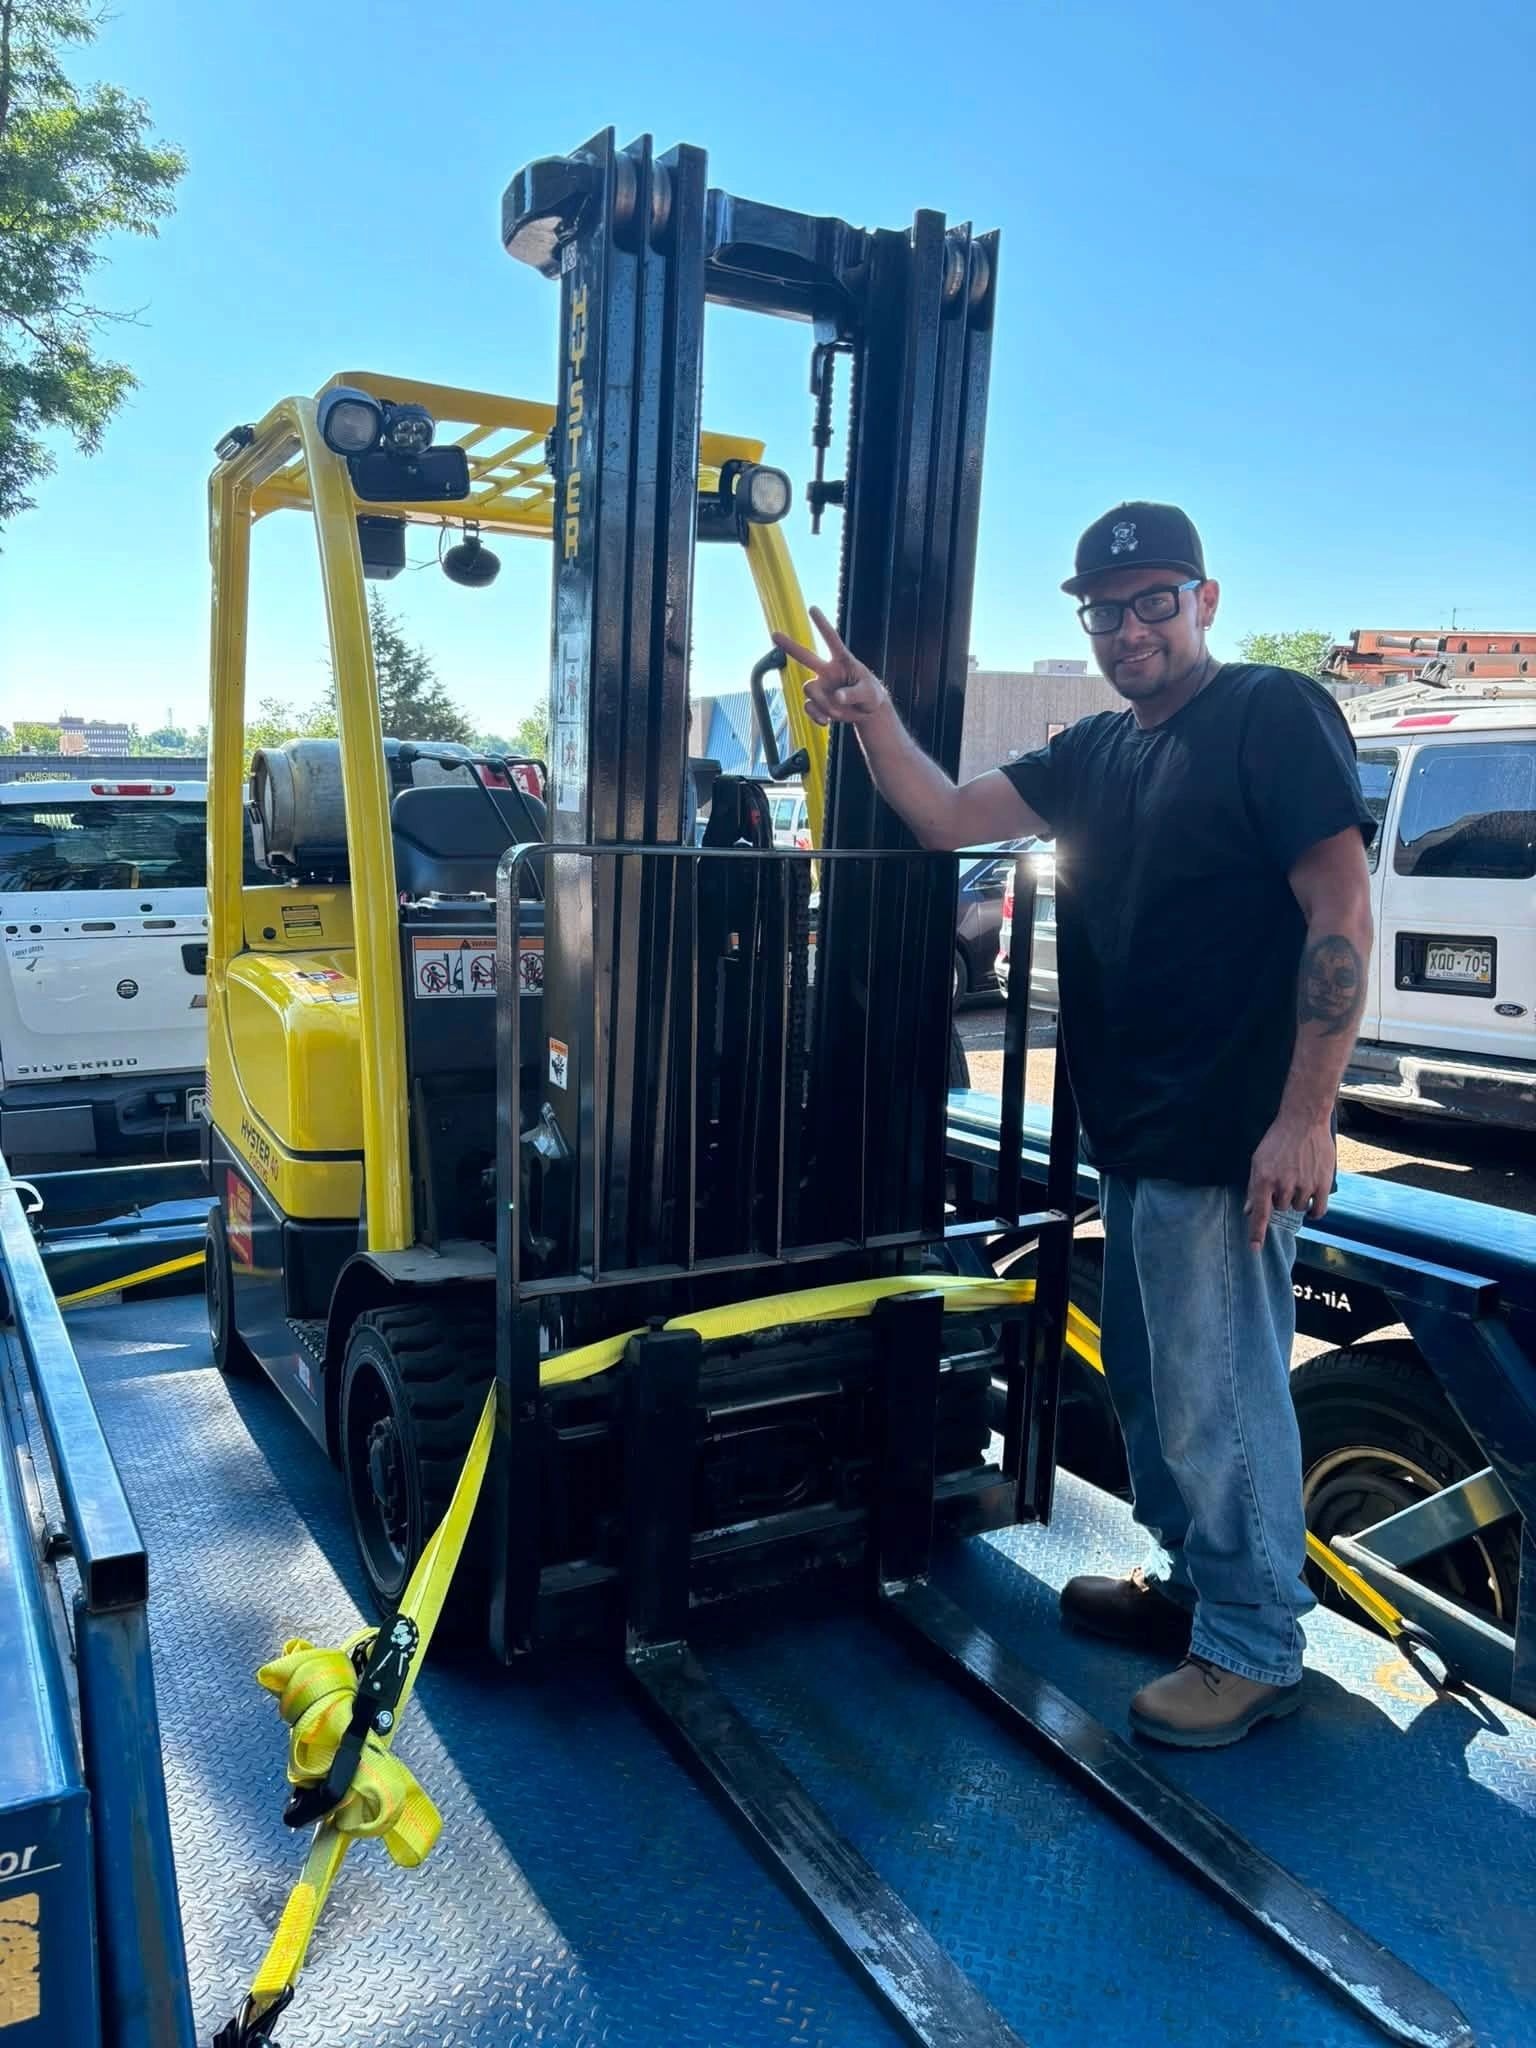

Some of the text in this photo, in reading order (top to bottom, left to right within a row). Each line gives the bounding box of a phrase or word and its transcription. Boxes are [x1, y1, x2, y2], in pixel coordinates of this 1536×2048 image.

[565, 283, 587, 559] HYSTER
[17, 1058, 138, 1074] SILVERADO
[241, 1117, 270, 1167] HYSTER
